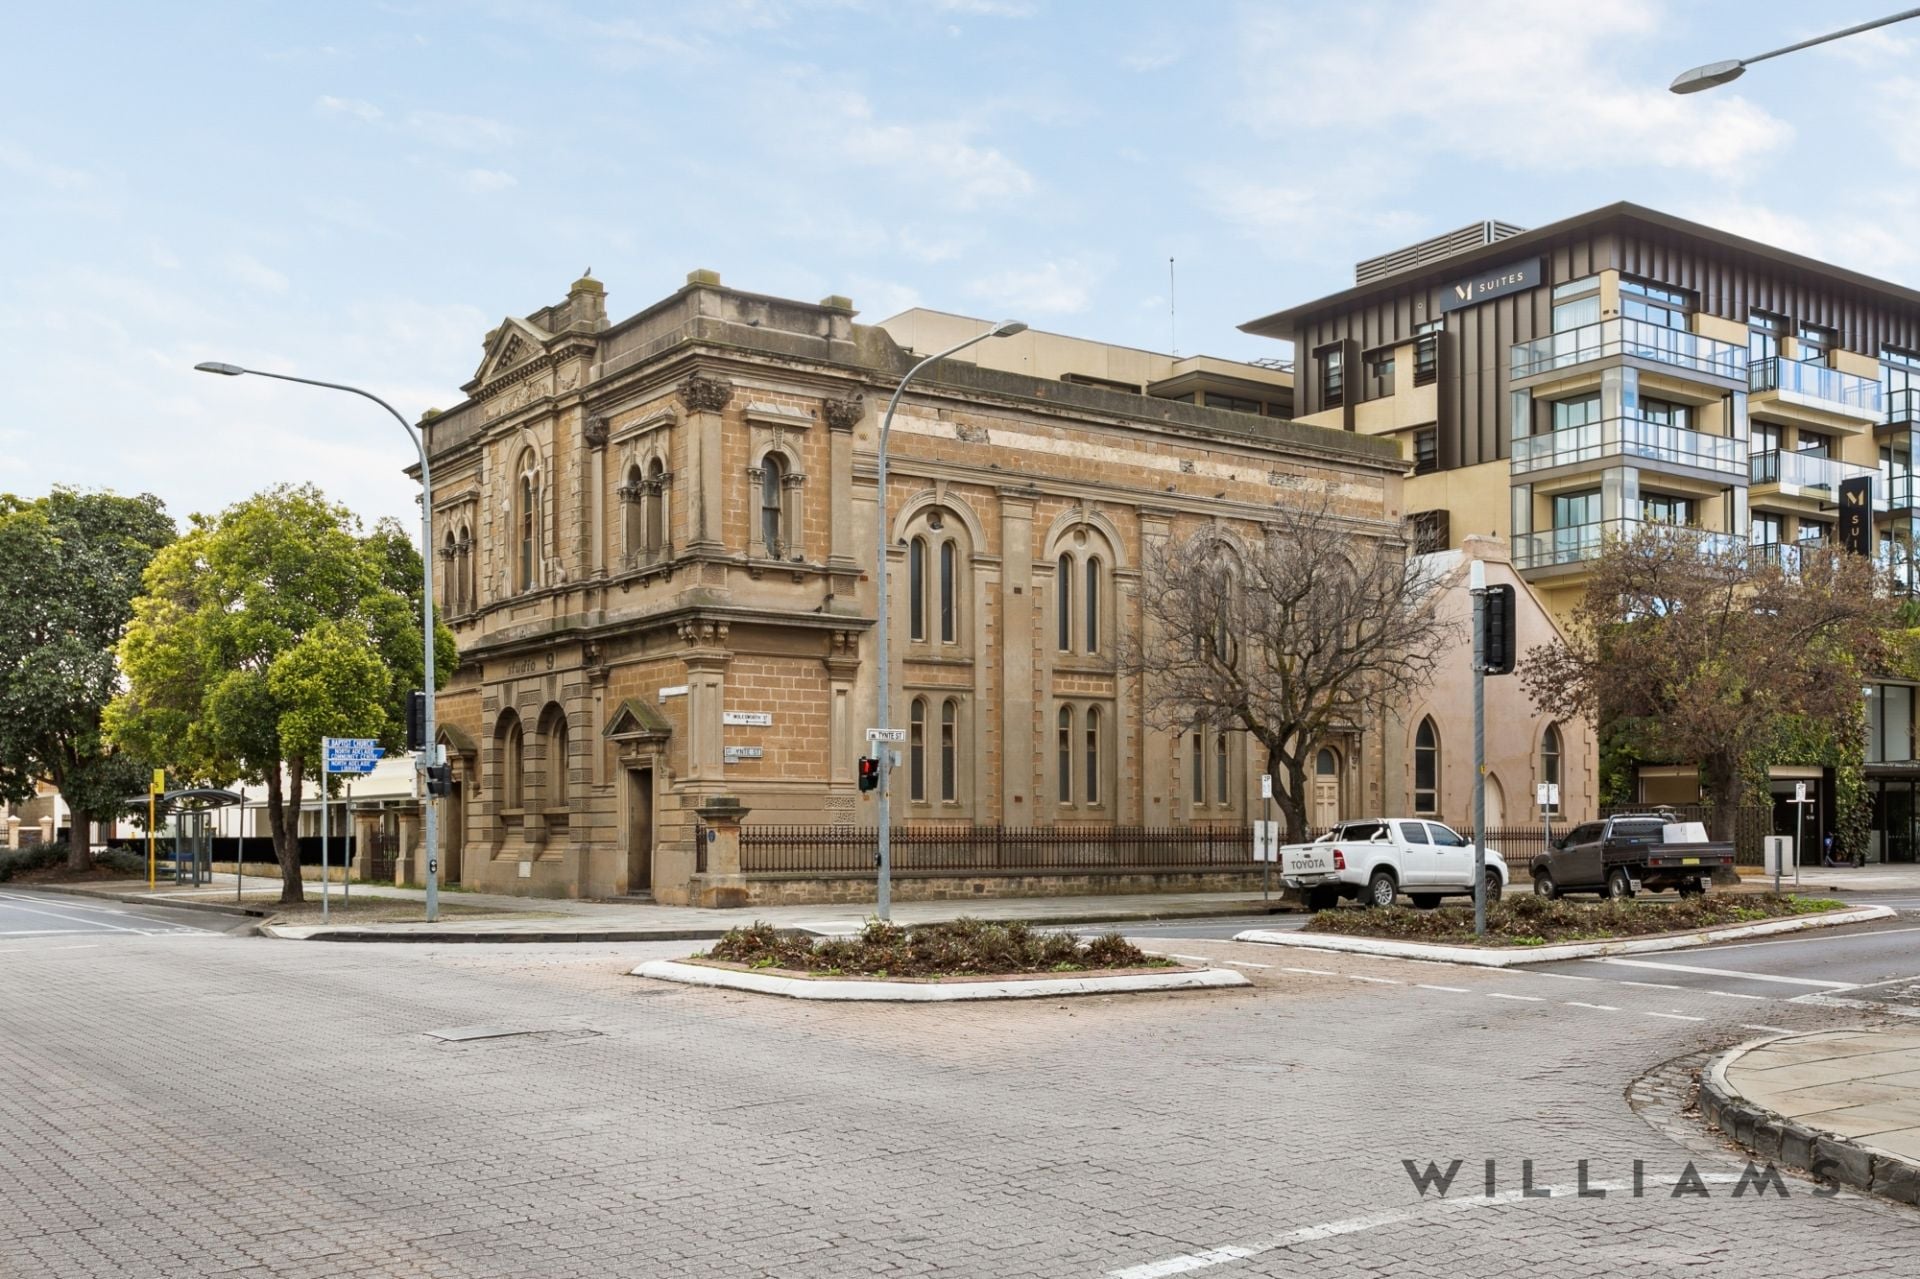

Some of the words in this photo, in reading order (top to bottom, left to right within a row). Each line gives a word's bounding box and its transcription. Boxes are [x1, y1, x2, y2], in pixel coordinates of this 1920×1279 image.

[1479, 271, 1524, 293] SUITES
[507, 656, 536, 675] studio
[546, 652, 555, 670] 9
[878, 731, 895, 740] TYNTE
[1291, 859, 1325, 870] TOYOTA
